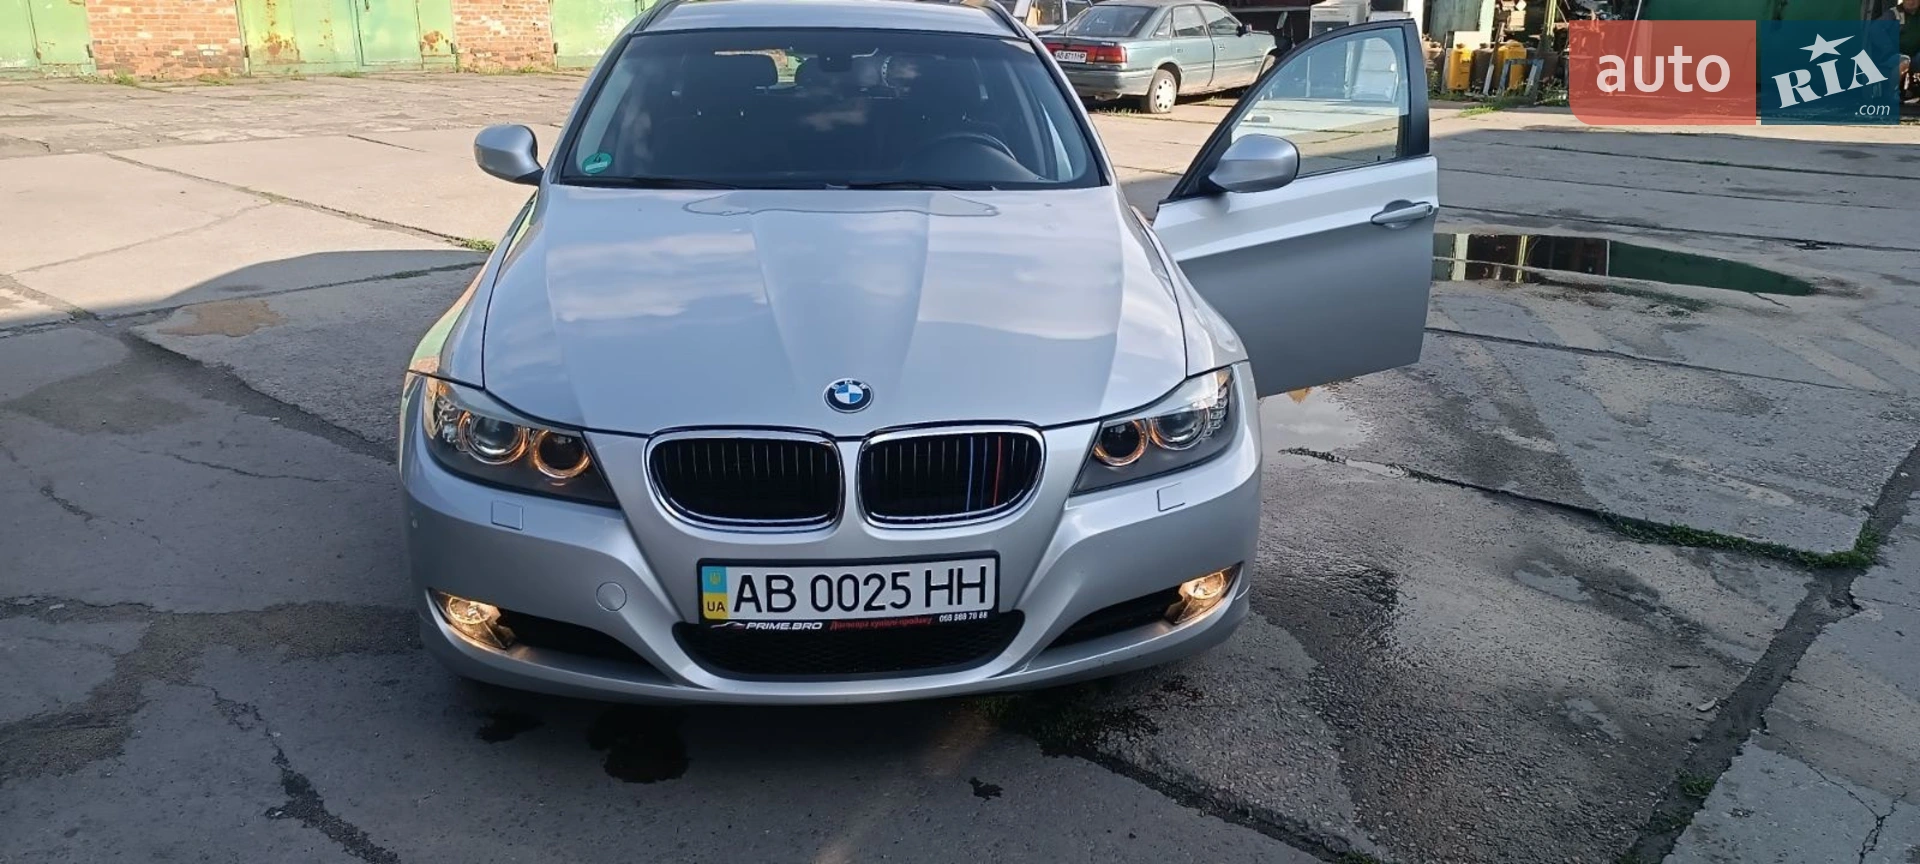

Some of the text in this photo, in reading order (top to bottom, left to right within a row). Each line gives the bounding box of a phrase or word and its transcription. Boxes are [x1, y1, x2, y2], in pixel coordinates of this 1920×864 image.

[734, 566, 987, 613] AB 0025 HH
[707, 602, 726, 612] UA
[745, 622, 823, 631] PRIME.BRO
